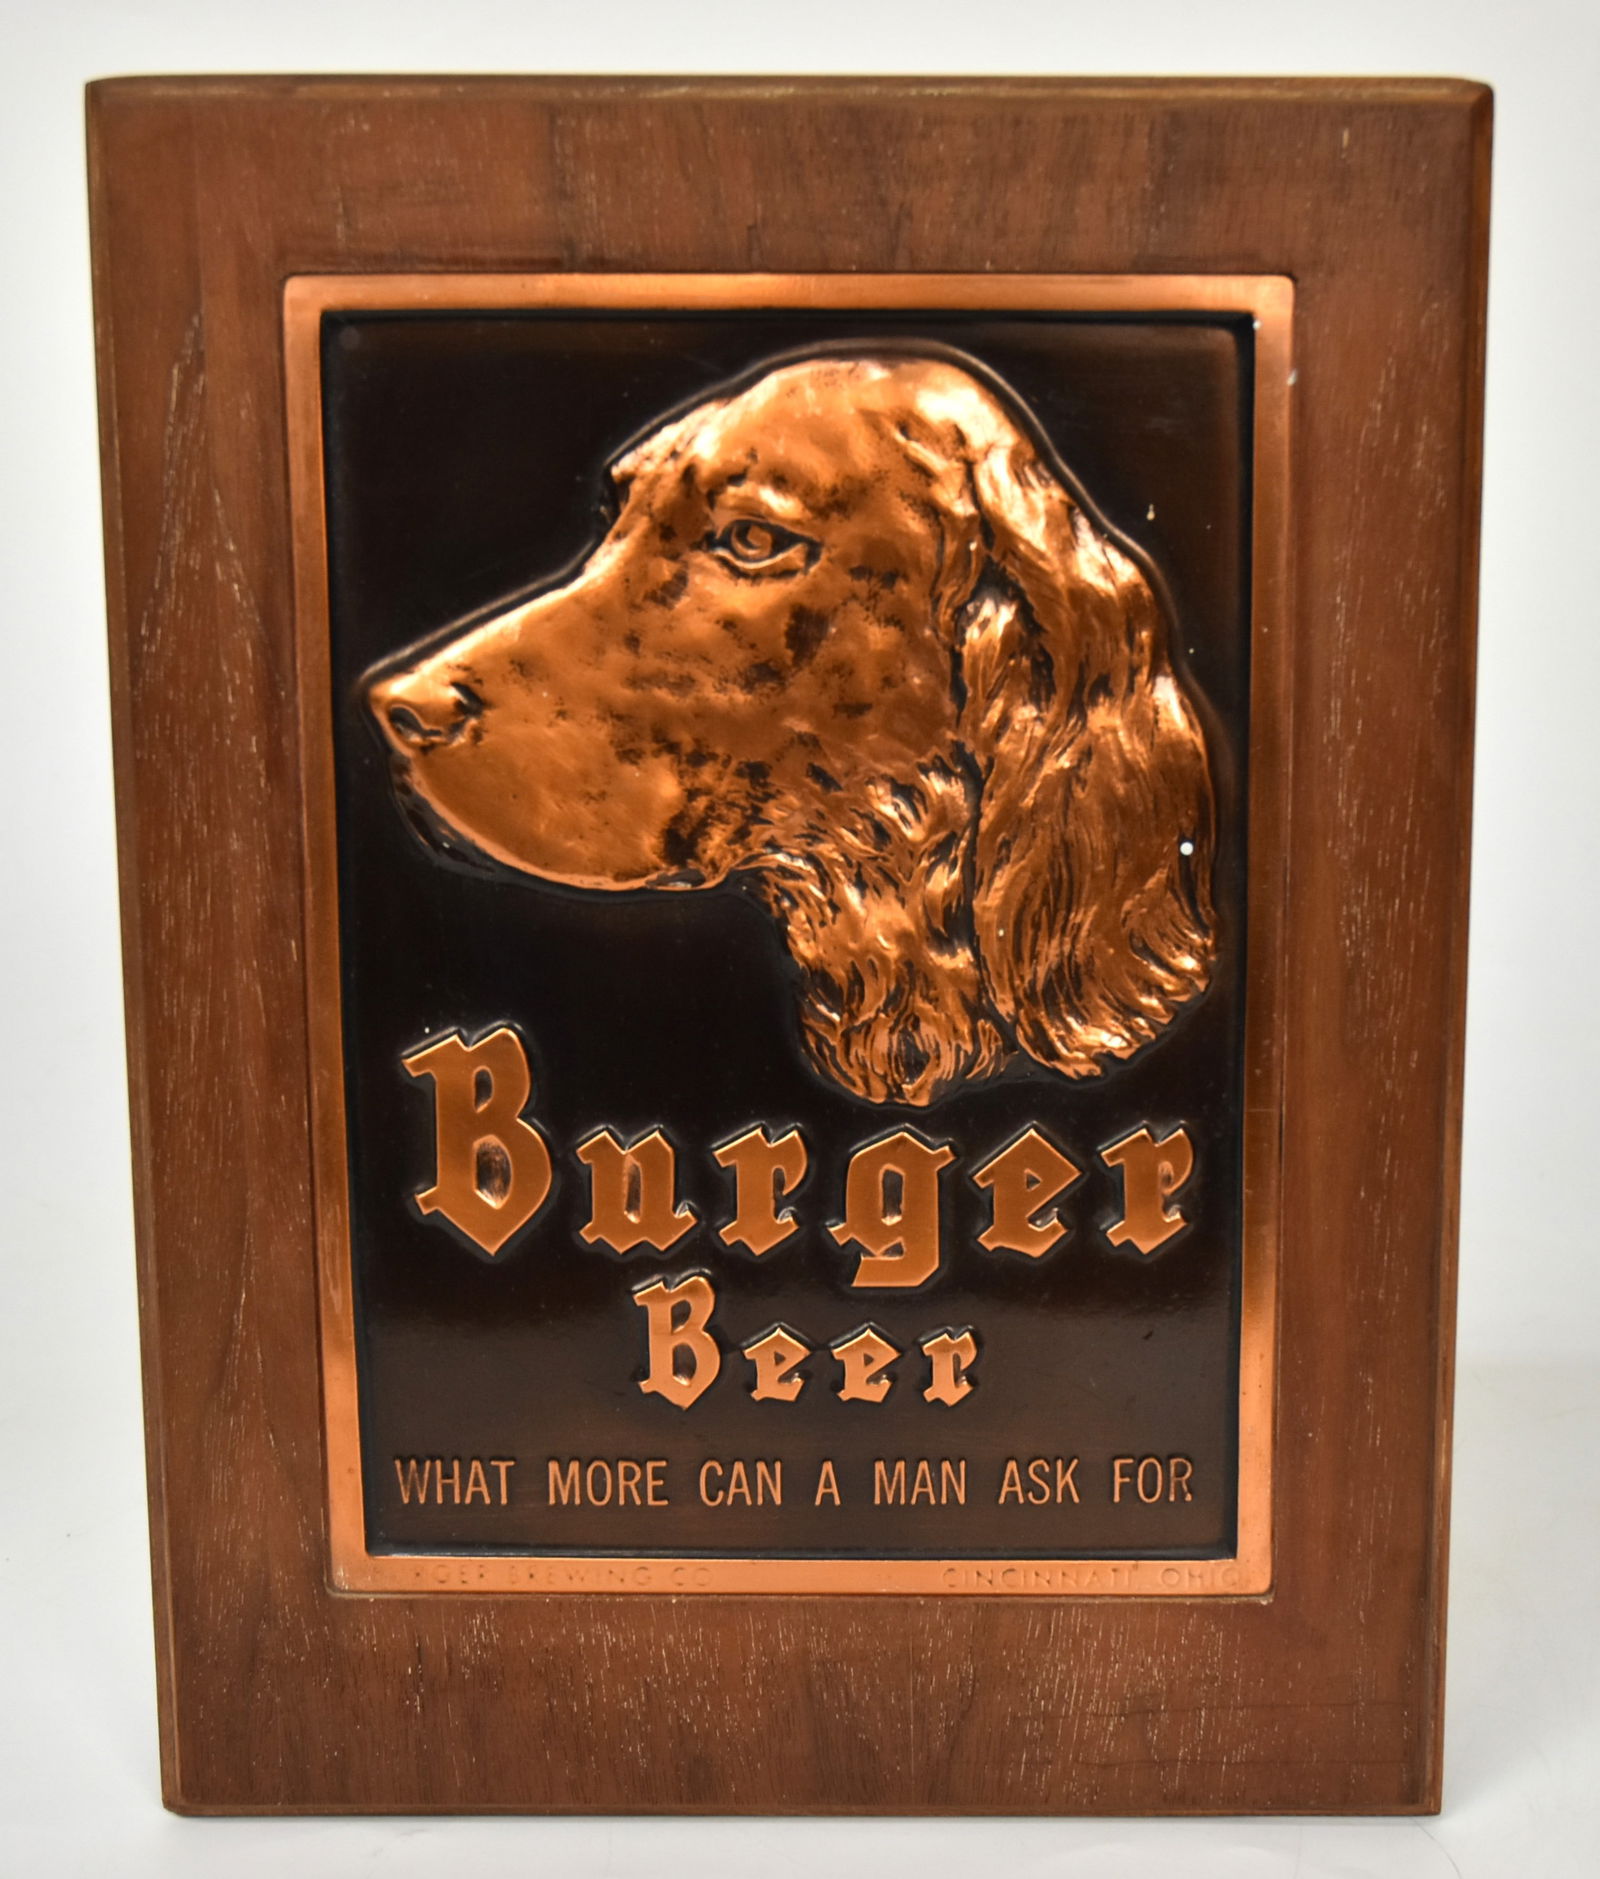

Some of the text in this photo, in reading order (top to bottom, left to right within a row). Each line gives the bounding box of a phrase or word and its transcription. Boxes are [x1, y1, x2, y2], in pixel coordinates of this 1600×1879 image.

[402, 1025, 1194, 1288] Burger
[632, 1273, 981, 1411] Beer
[394, 1457, 1195, 1507] WHAT MORE CAN A MAN ASK FOR
